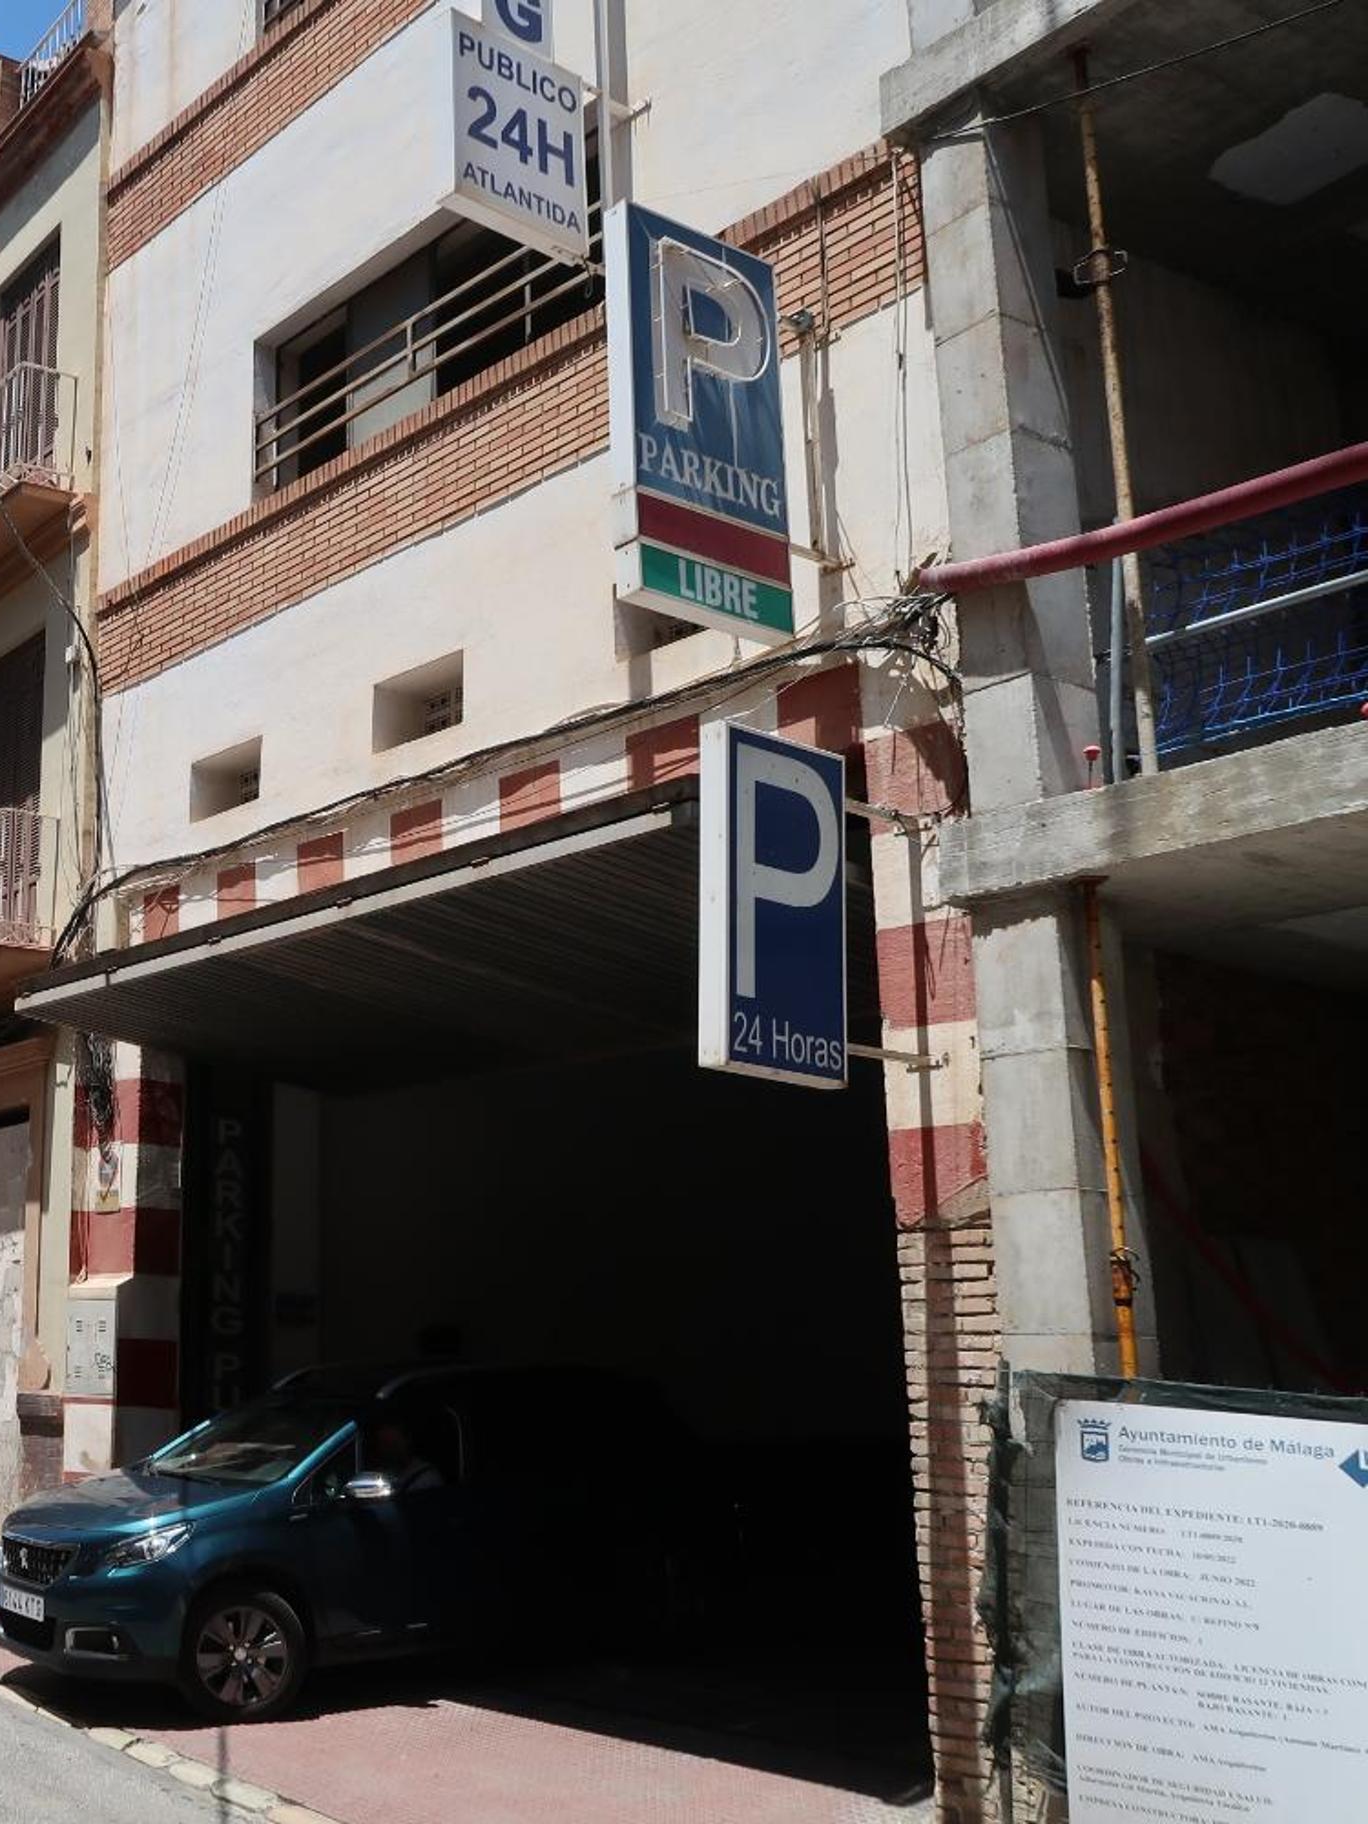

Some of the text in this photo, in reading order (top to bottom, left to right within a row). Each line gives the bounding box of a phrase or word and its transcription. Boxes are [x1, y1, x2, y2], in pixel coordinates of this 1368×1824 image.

[458, 31, 578, 114] PUBLICO
[466, 85, 576, 188] 24H
[462, 160, 583, 235] ATLANTIDA
[652, 236, 771, 431] P
[637, 432, 781, 518] PARKING
[677, 558, 759, 621] LIBRE
[736, 741, 838, 999] P
[733, 1010, 842, 1071] 24 Horas
[209, 1117, 246, 1336] PARKING
[1118, 1425, 1238, 1450] Ayuntamiento
[1242, 1437, 1265, 1451] de
[1066, 1497, 1137, 1512] REFERENCIA
